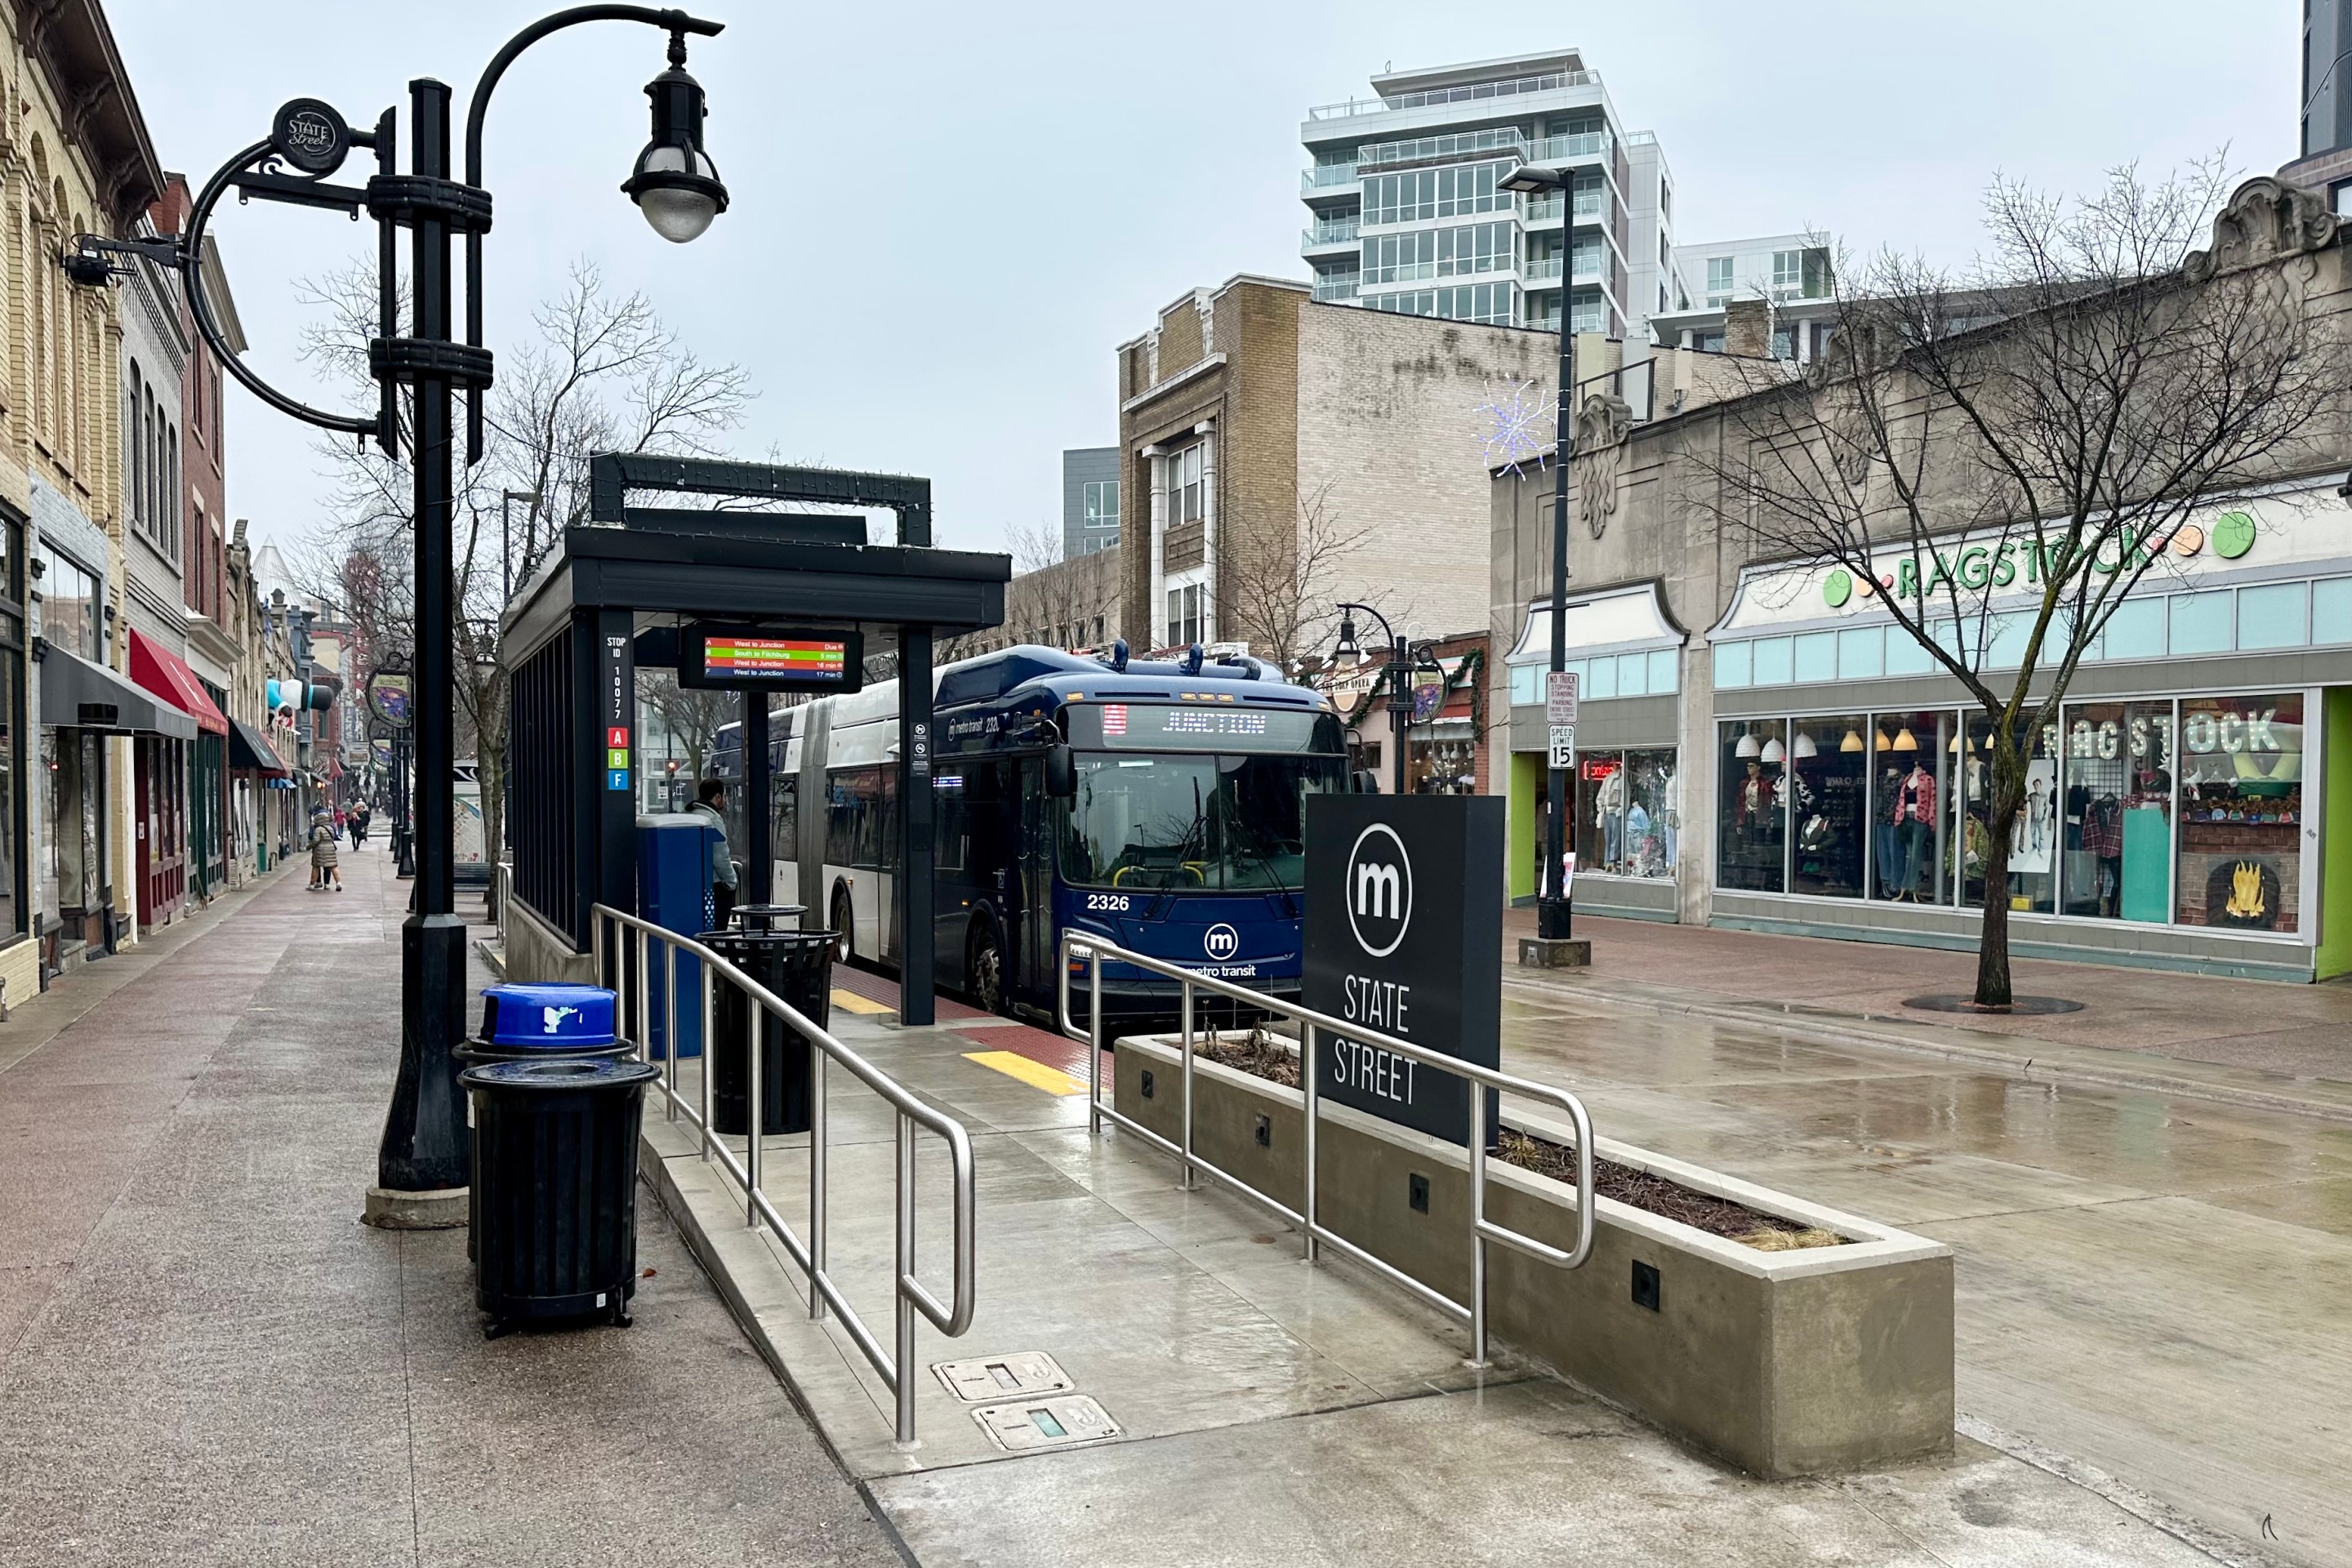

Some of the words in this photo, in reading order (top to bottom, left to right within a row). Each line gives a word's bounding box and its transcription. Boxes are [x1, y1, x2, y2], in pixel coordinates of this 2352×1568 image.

[288, 119, 328, 139] STATE
[288, 132, 327, 145] Street
[607, 637, 626, 647] STOP
[612, 648, 621, 658] ID
[733, 649, 751, 657] South
[761, 650, 790, 659] Fitchburg
[1351, 678, 1370, 689] OPERA
[1549, 675, 1557, 684] NO
[1559, 675, 1576, 684] TRUCK
[956, 721, 969, 733] metro
[969, 716, 983, 733] transit
[1162, 711, 1266, 734] JUNCTION
[613, 731, 622, 745] A
[1551, 728, 1573, 737] SPEED
[1553, 737, 1570, 746] LIMIT
[614, 752, 622, 766] B
[1552, 746, 1570, 764] 15
[1087, 894, 1129, 911] 2326
[1221, 964, 1257, 977] transit
[1343, 973, 1410, 1033] STATE
[1334, 1037, 1418, 1106] STREET
